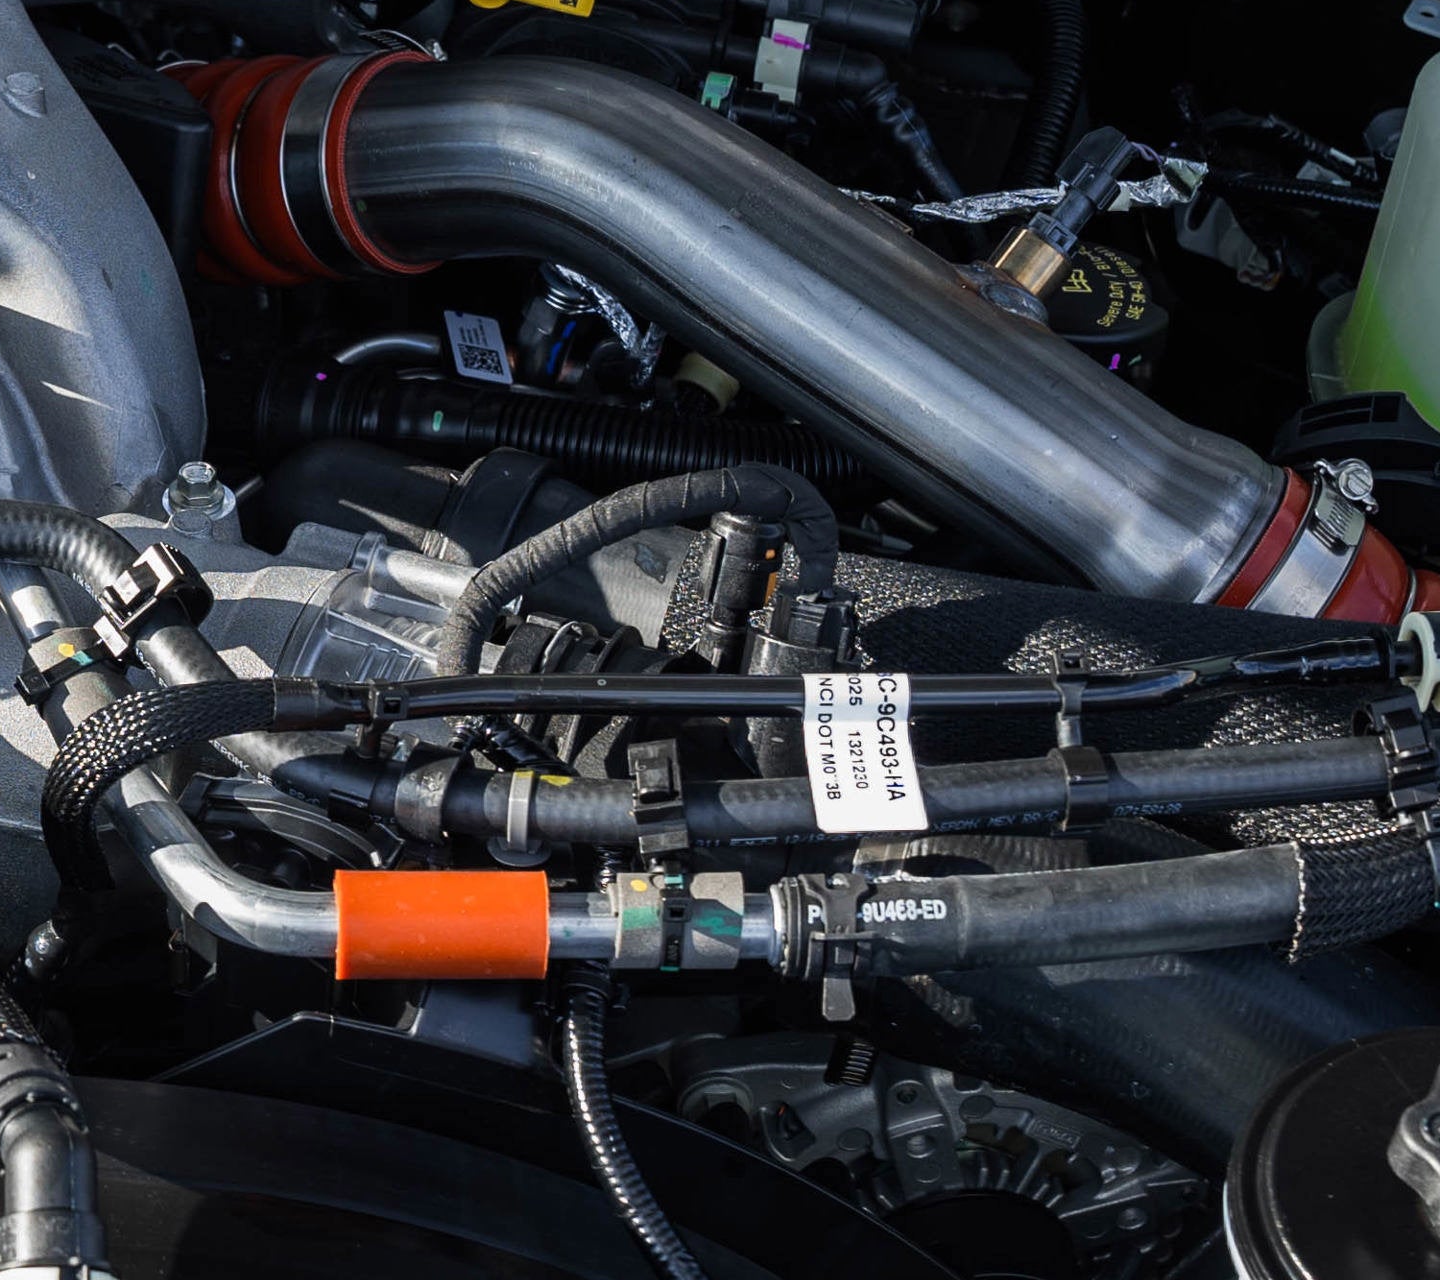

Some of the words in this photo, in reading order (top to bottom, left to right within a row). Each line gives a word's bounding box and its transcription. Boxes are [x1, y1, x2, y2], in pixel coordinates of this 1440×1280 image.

[818, 677, 834, 707] NCI
[818, 713, 833, 748] DOT
[848, 731, 869, 789] 1321230
